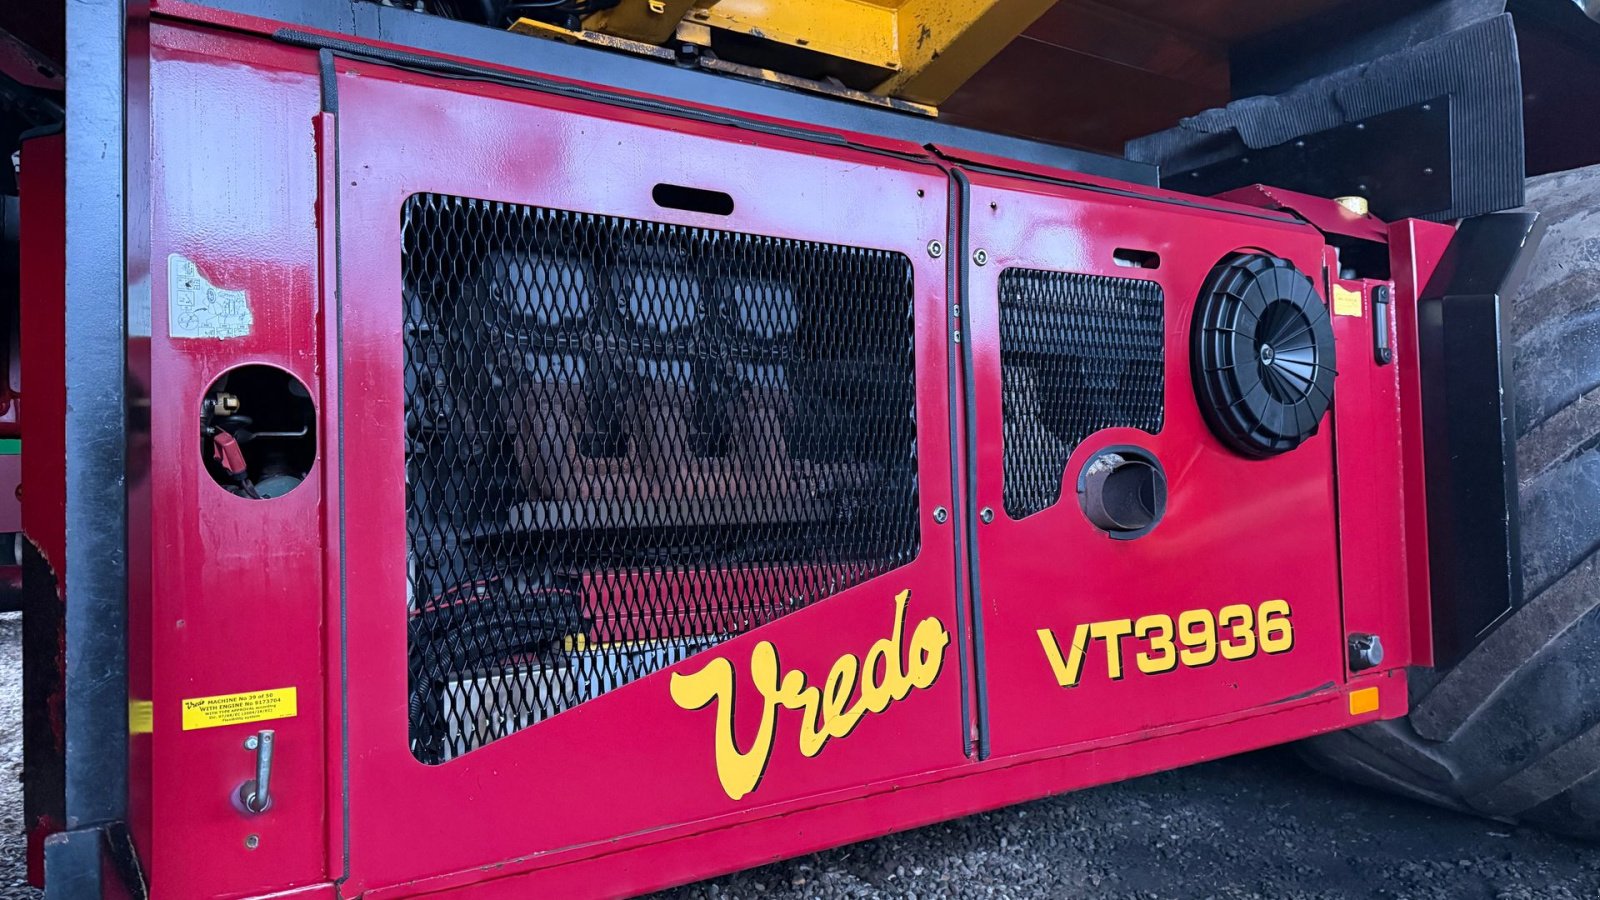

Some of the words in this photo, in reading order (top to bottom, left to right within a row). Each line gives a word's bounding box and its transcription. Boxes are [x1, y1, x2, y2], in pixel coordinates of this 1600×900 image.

[1037, 599, 1294, 687] VT3936
[207, 697, 237, 705] MACHINE
[670, 588, 950, 800] Vredo
